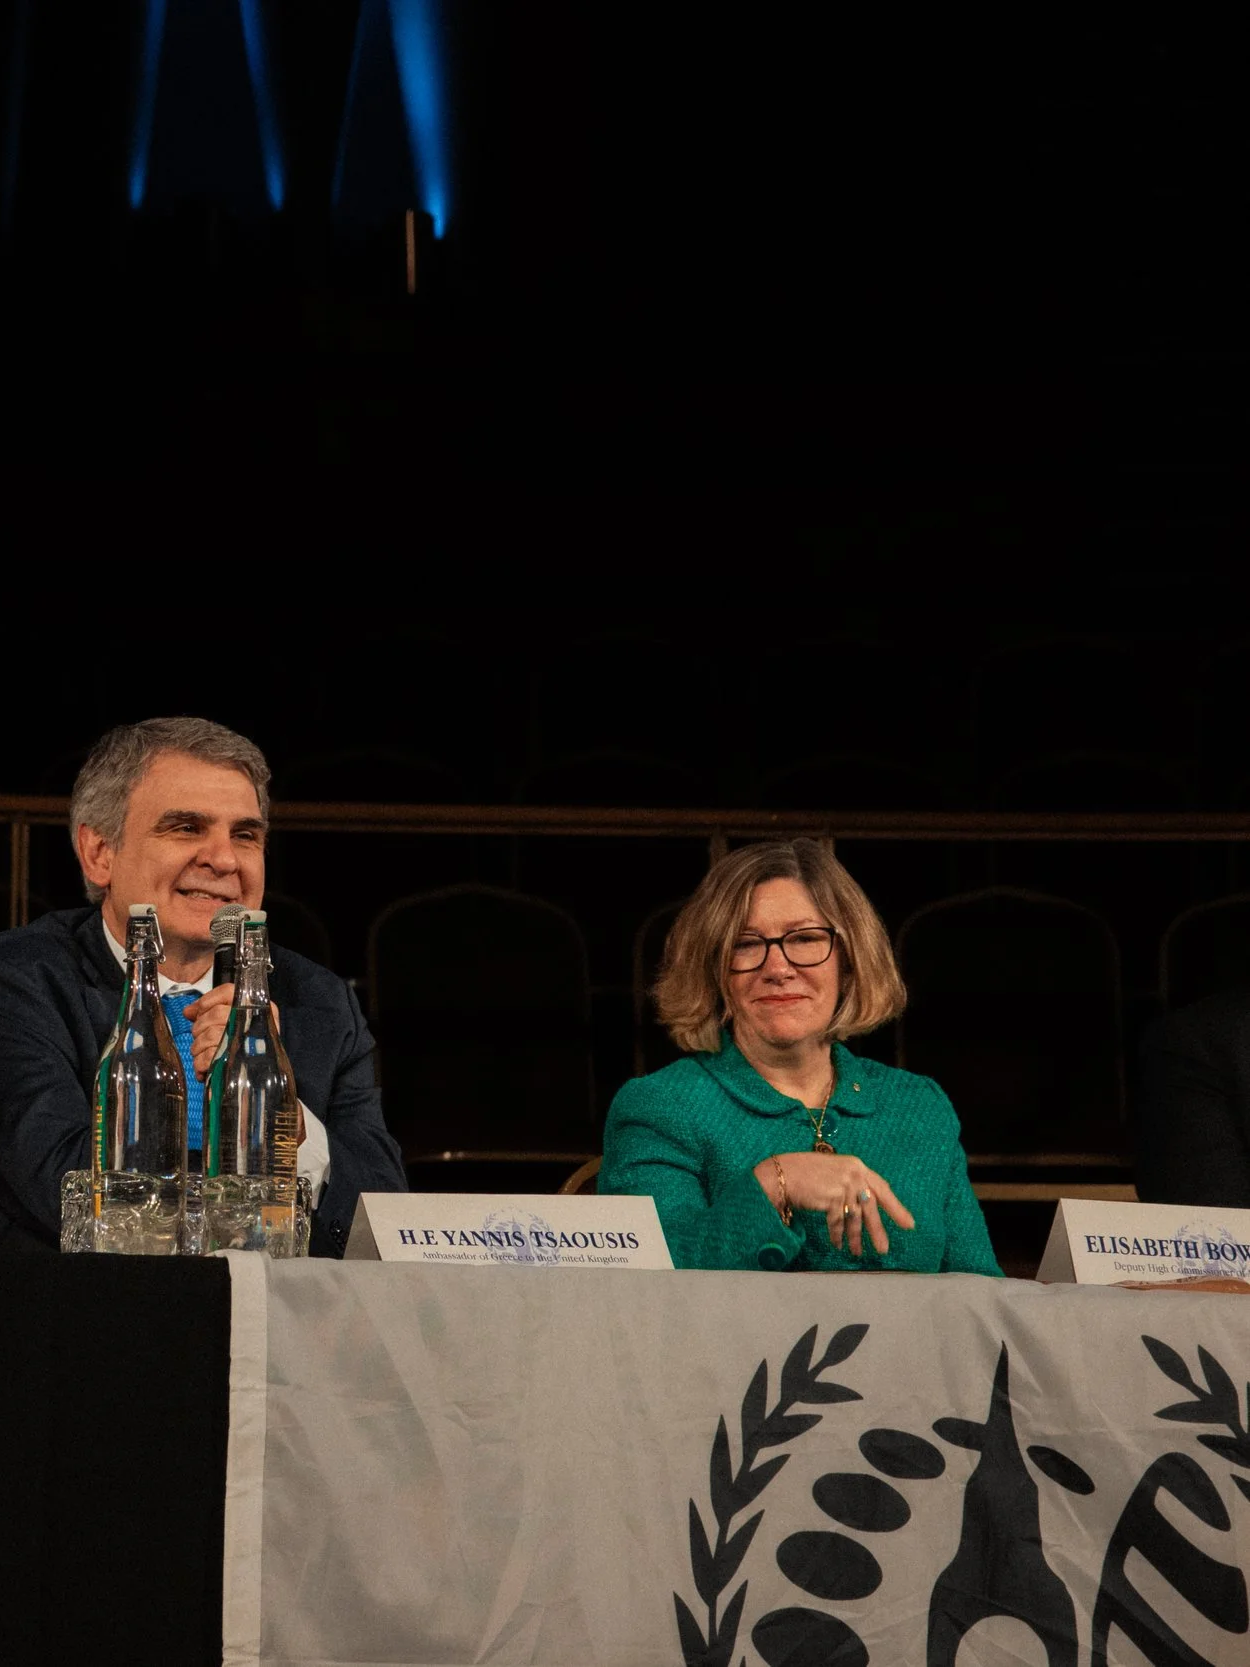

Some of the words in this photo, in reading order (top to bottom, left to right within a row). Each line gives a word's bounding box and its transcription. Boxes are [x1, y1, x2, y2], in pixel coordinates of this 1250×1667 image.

[398, 1229, 439, 1246] H.E
[441, 1230, 525, 1248] YANNIS
[530, 1231, 639, 1249] TSAOUSIS
[1085, 1235, 1201, 1259] ELISABETH
[422, 1251, 478, 1261] Ambassador
[480, 1252, 490, 1261] of
[491, 1253, 524, 1262] Greece
[526, 1254, 535, 1262] to
[537, 1253, 552, 1263] the
[587, 1255, 630, 1265] Kingdom
[1114, 1261, 1146, 1274] Deputy
[1149, 1263, 1170, 1275] High
